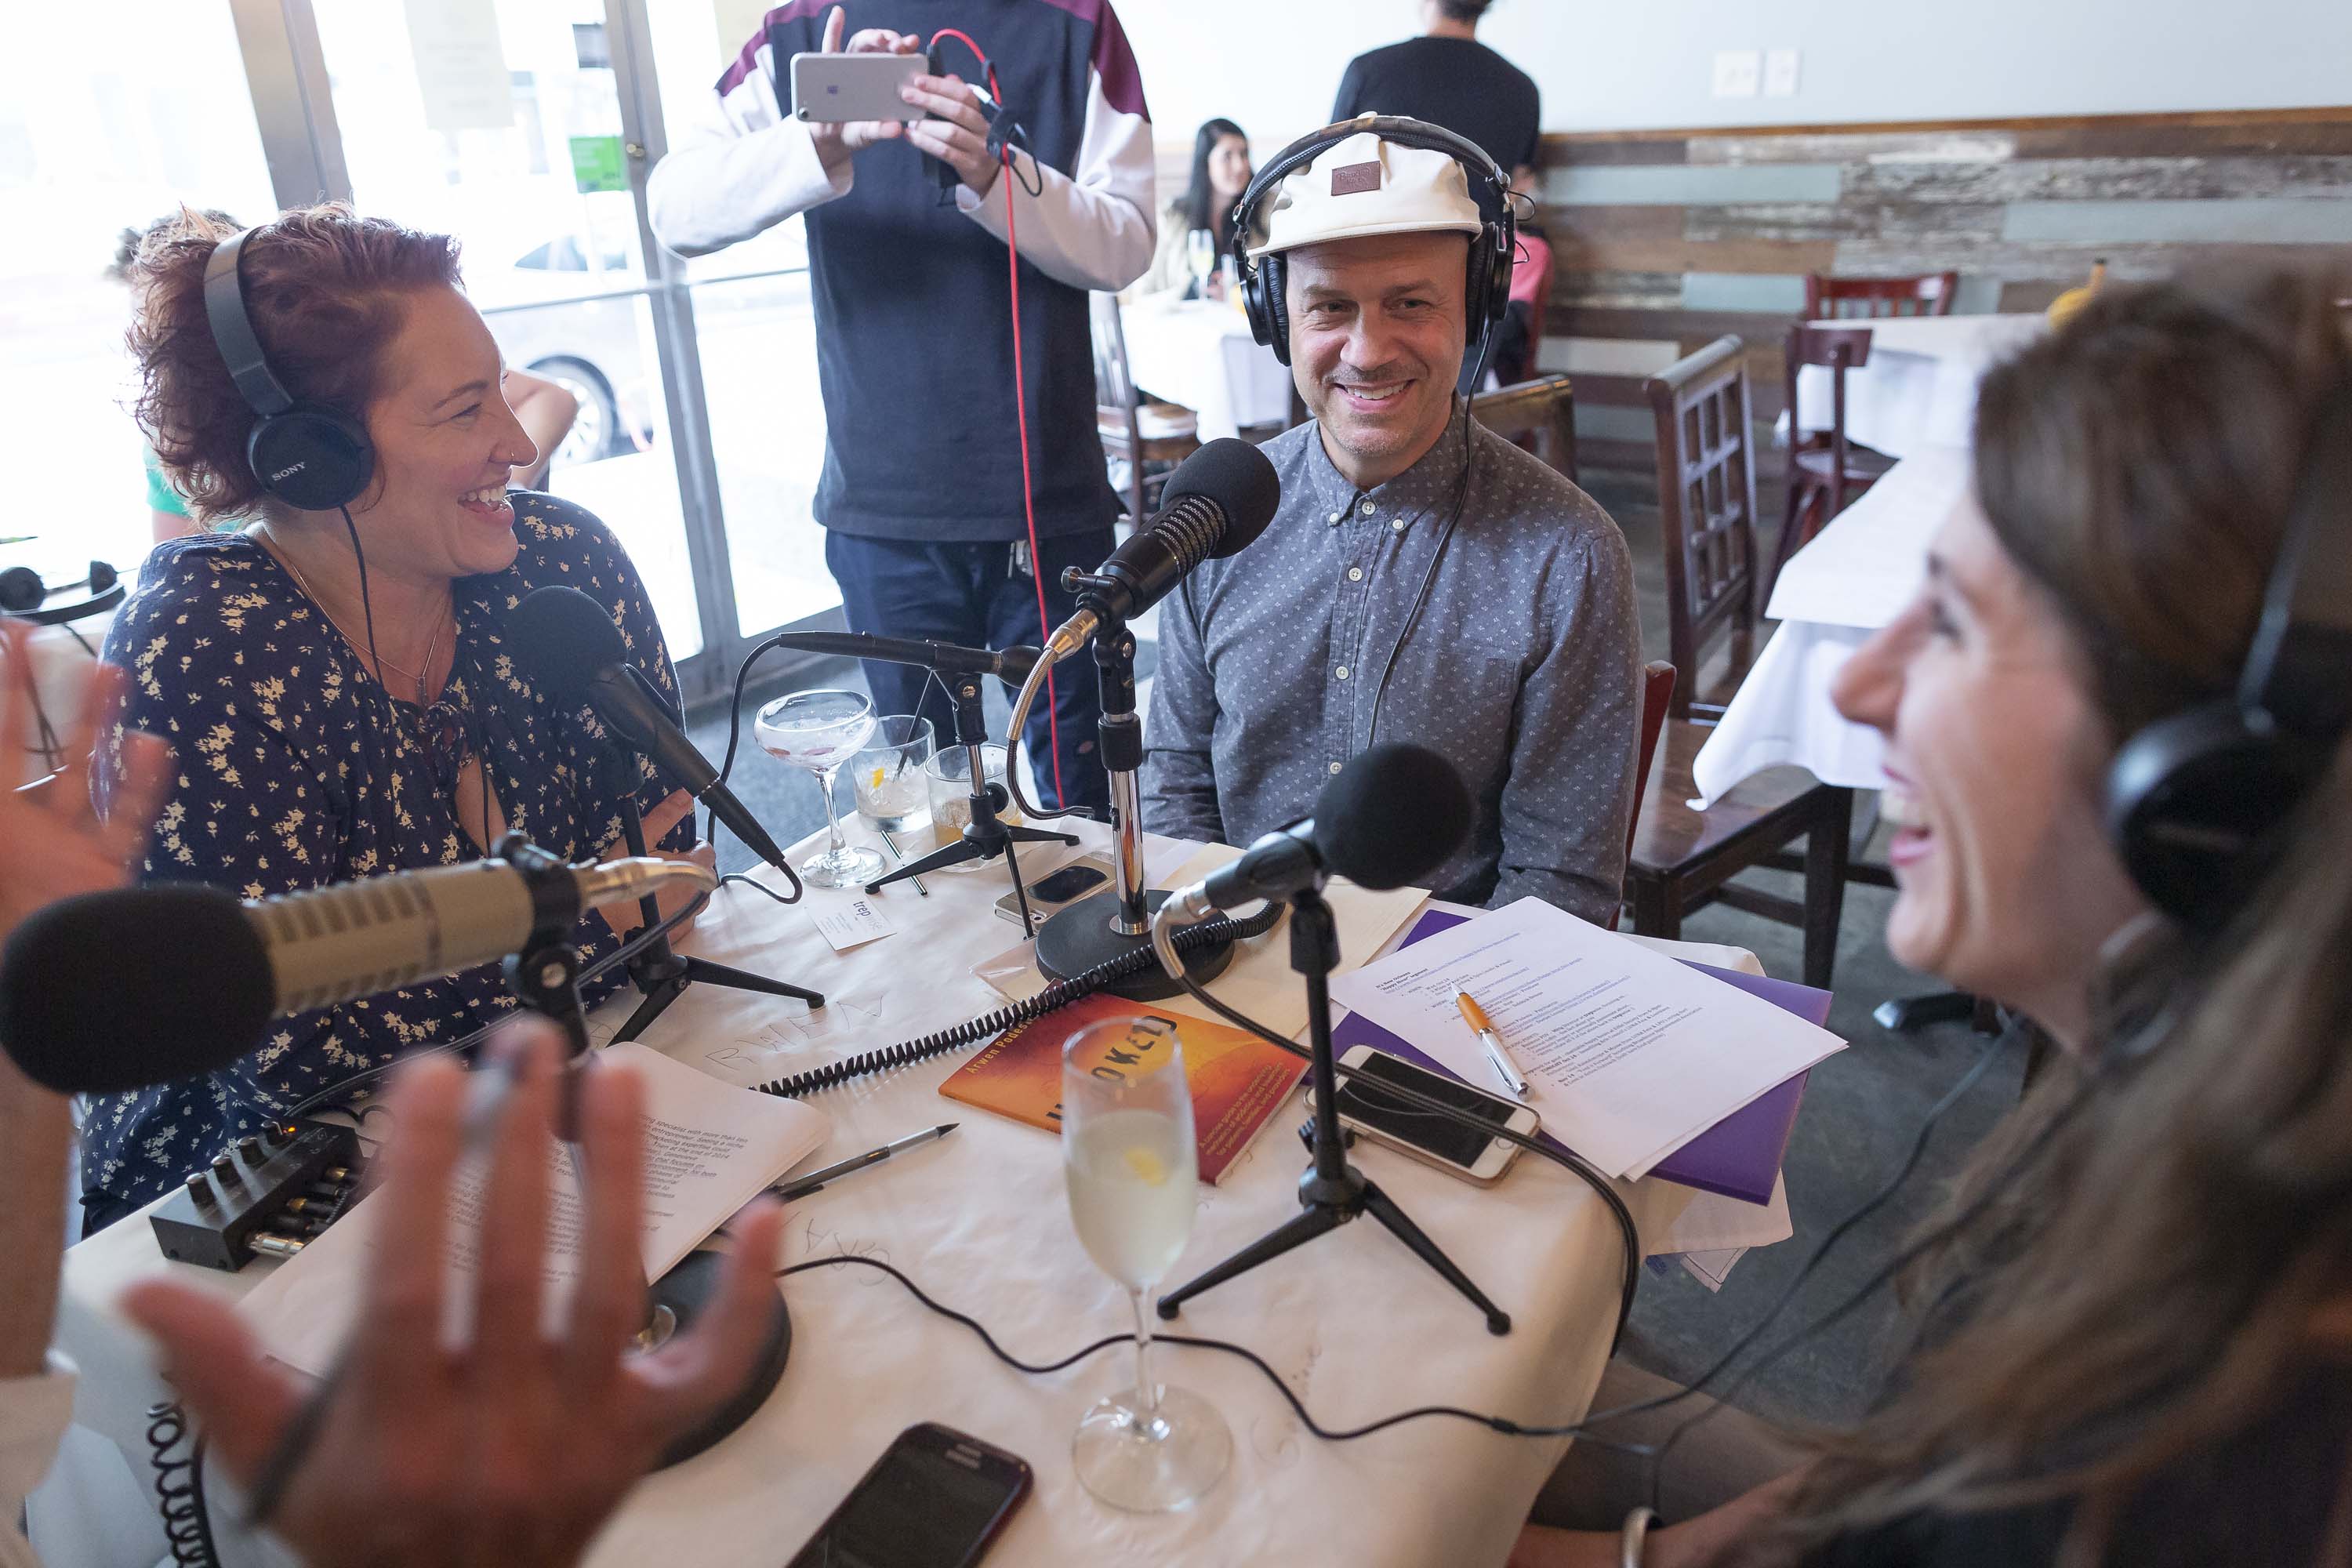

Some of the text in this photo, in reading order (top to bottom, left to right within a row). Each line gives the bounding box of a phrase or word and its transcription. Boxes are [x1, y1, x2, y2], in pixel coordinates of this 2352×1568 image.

[272, 461, 306, 481] SONY
[965, 1018, 1033, 1073] Arwen Podes
